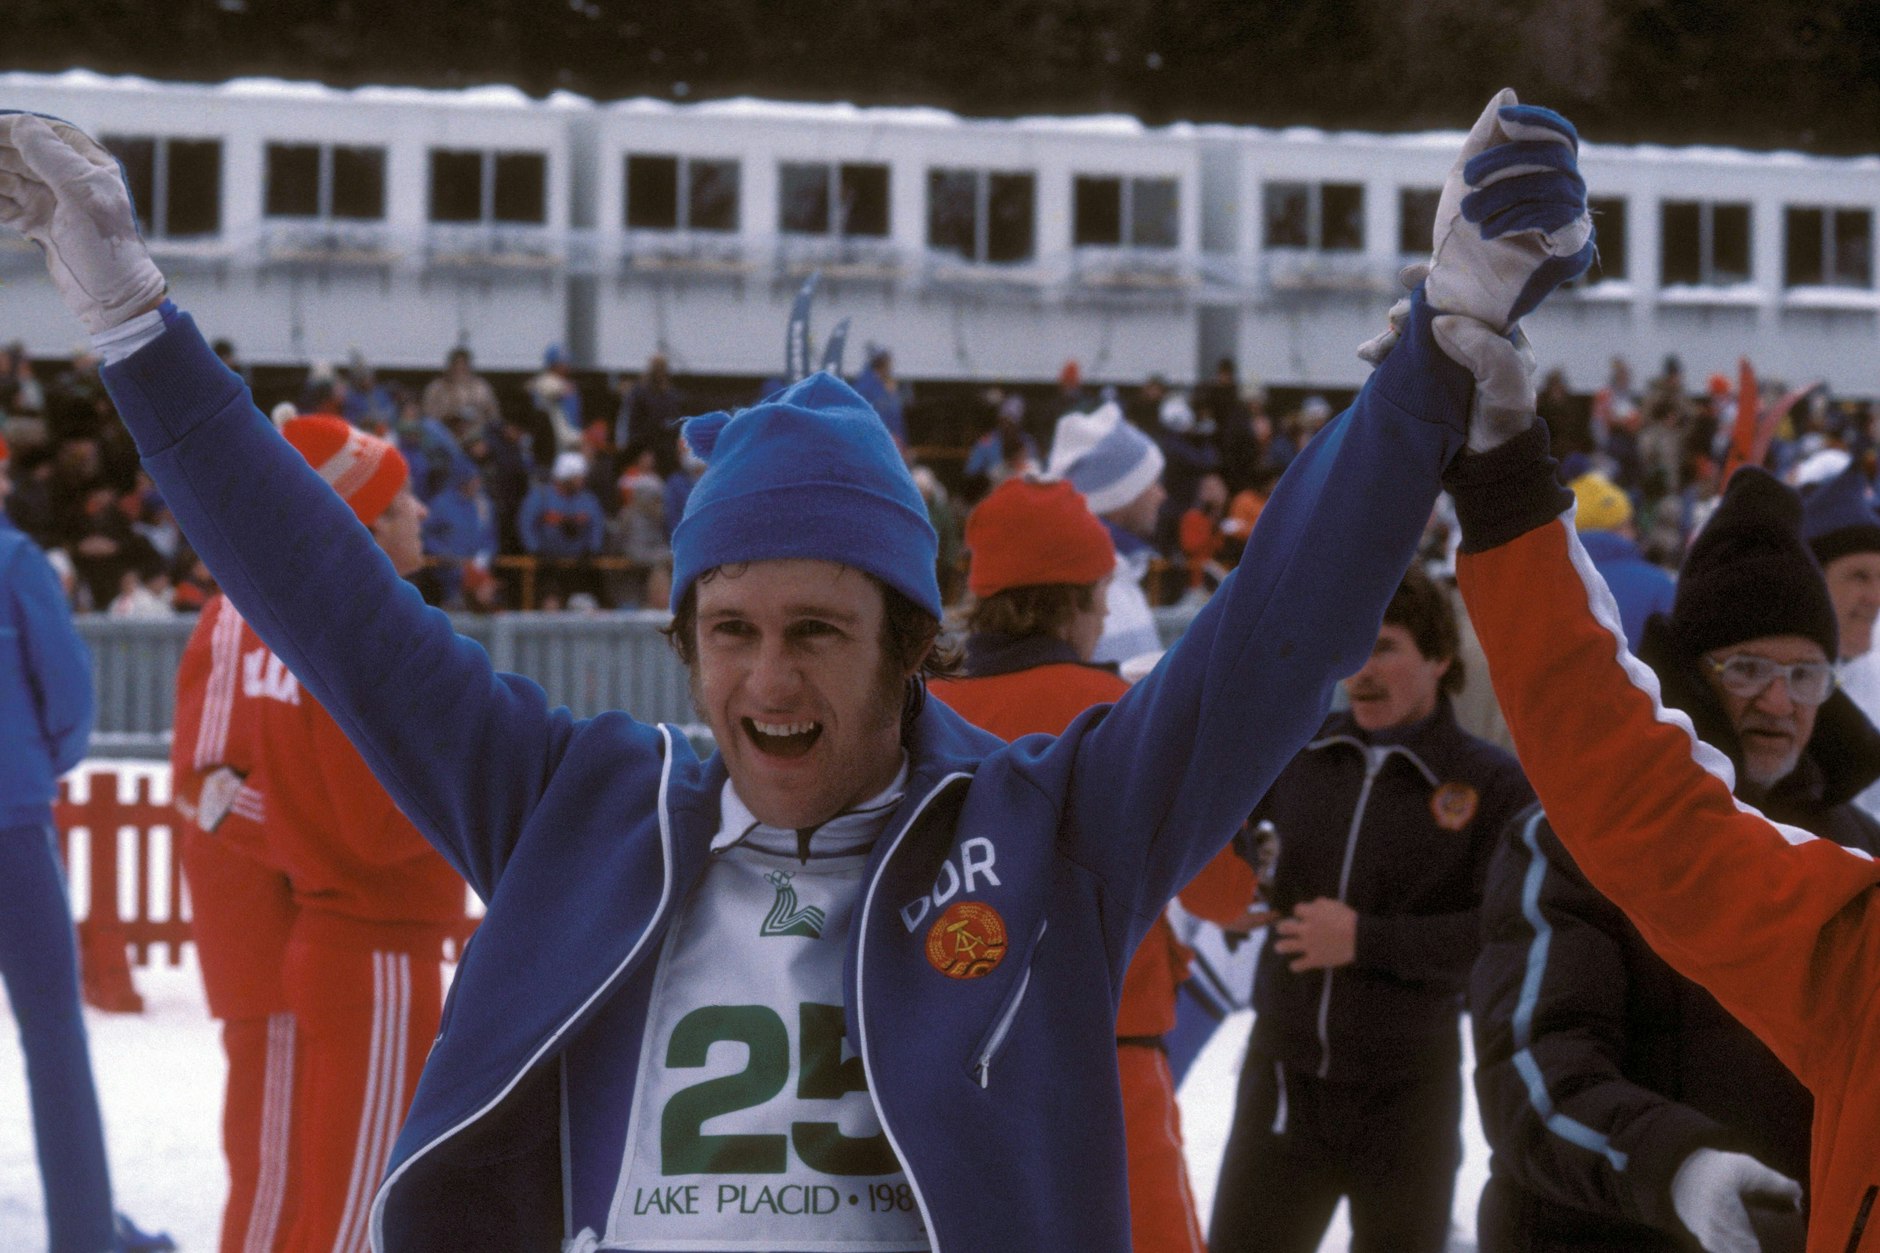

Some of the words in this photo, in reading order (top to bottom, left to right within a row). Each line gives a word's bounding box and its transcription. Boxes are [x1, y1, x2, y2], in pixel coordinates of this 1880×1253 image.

[900, 837, 1001, 933] DDR
[661, 1002, 901, 1176] 25
[634, 1186, 699, 1215] LAKE
[717, 1184, 840, 1215] PLACID
